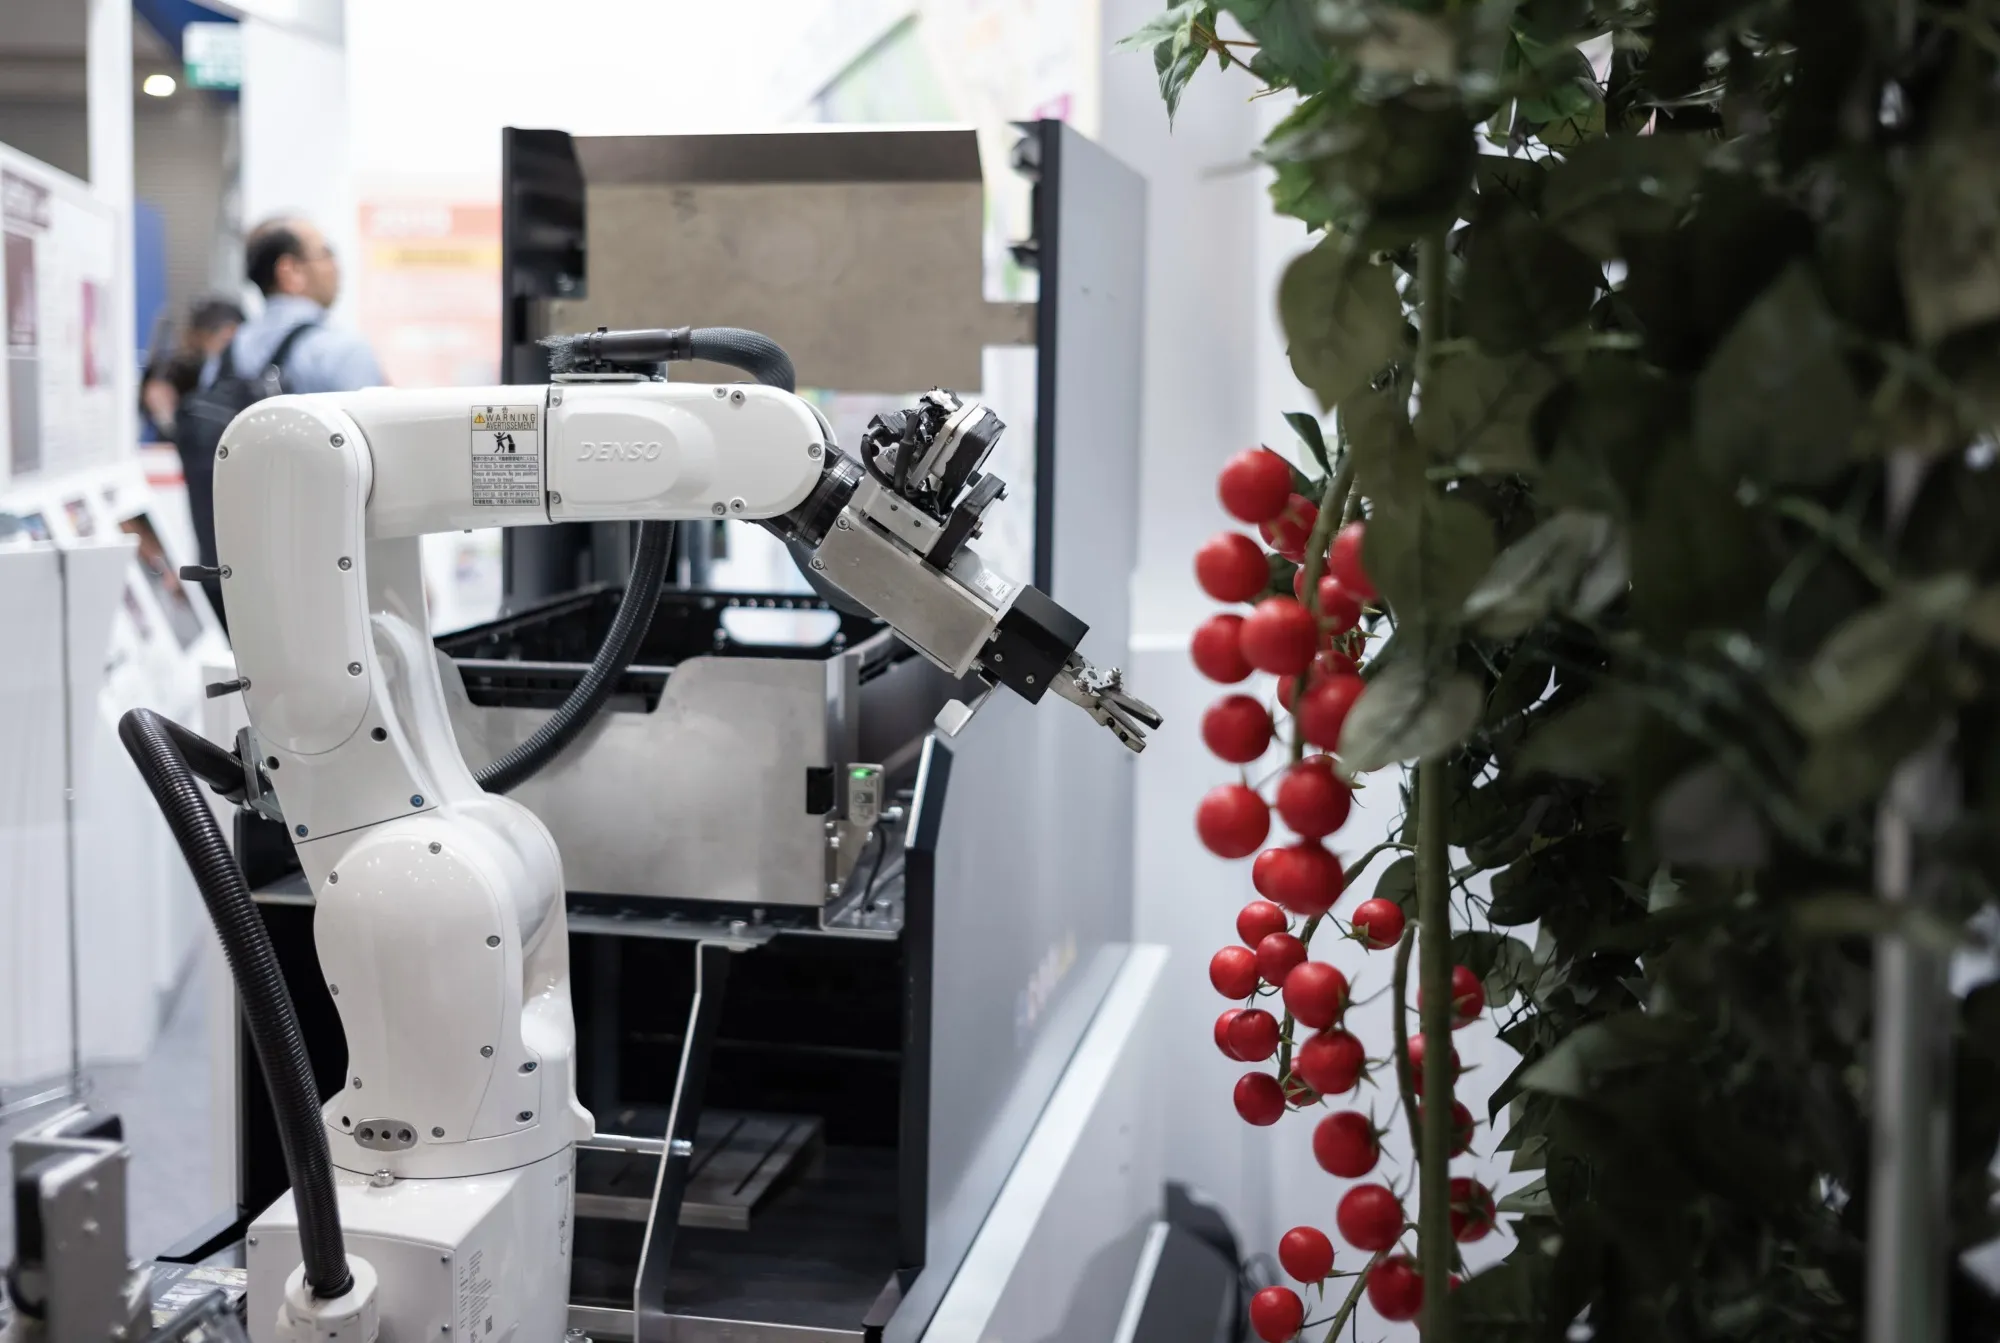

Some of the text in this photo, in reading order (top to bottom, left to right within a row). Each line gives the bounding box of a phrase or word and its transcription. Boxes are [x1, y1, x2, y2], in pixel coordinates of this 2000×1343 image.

[486, 413, 536, 422] WARNING
[486, 421, 535, 430] AVERTISSEMENT
[577, 441, 662, 462] DENSO
